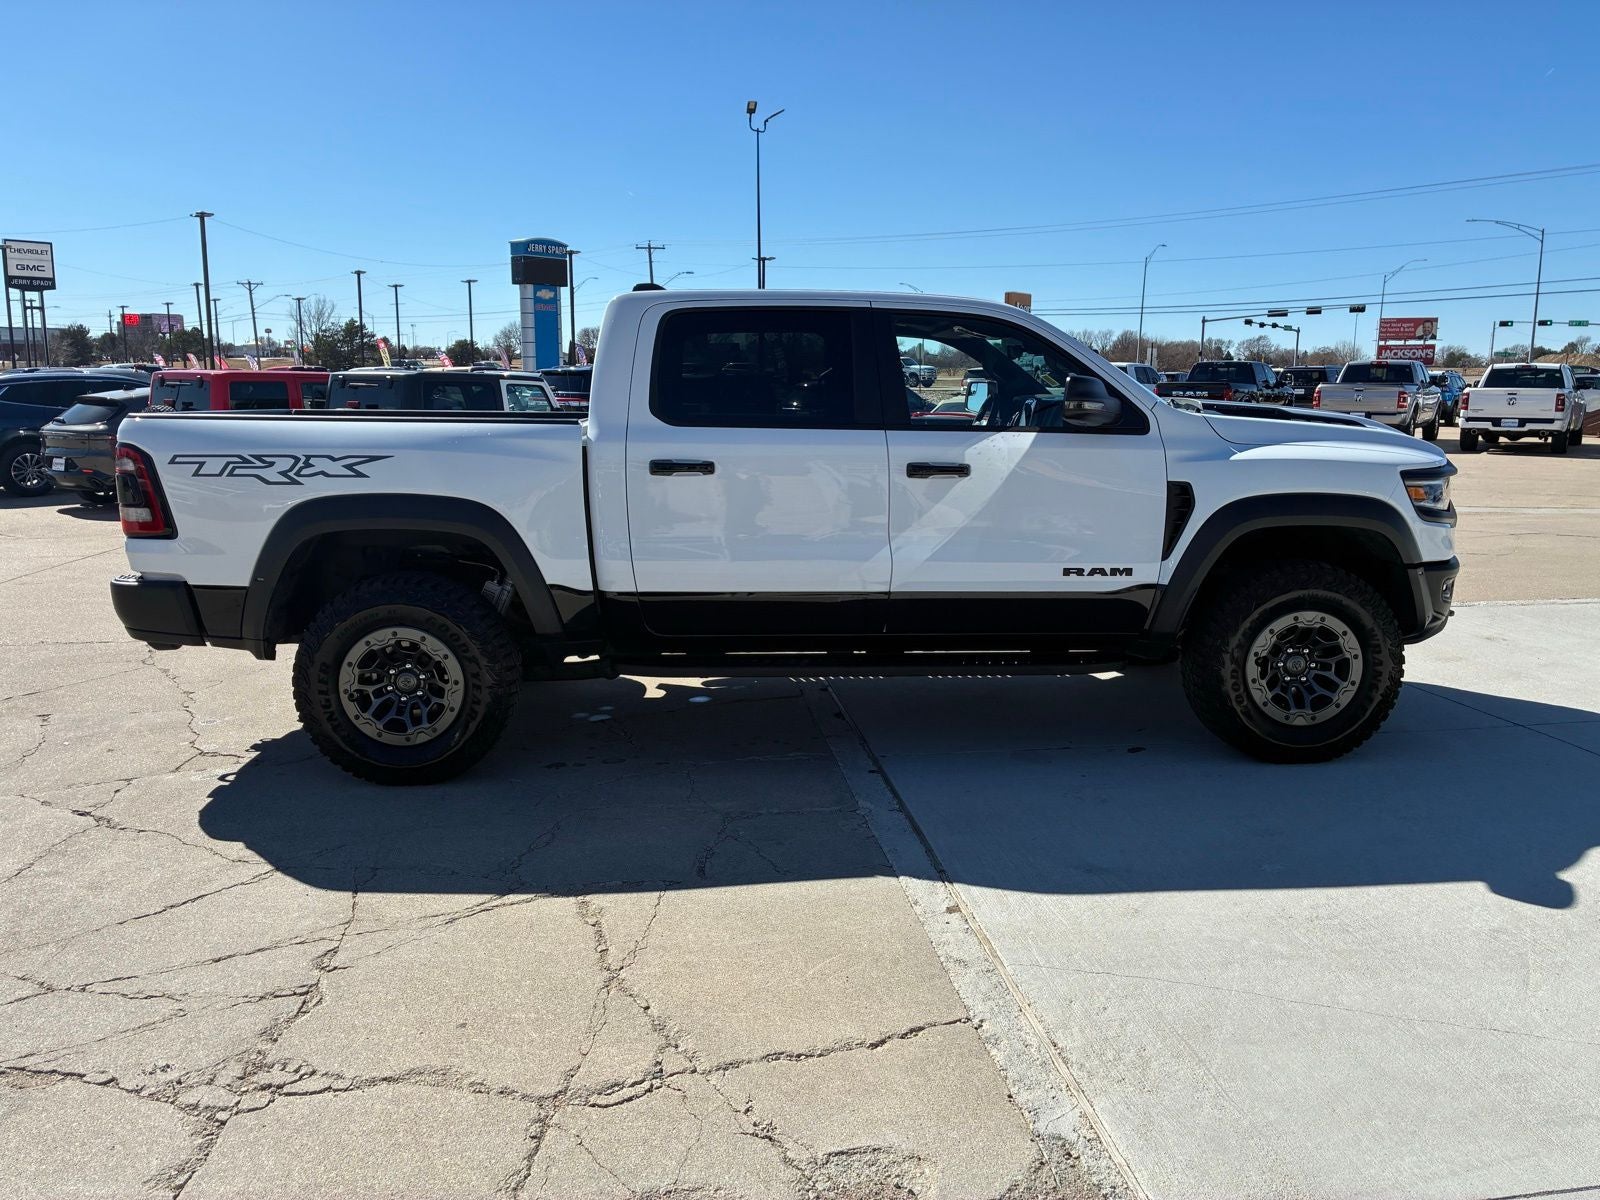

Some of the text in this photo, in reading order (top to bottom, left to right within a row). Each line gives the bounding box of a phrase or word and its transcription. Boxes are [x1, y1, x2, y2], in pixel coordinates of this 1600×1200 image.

[10, 247, 48, 255] CHEVROLET
[528, 243, 547, 253] JERRY
[16, 264, 46, 272] GMC
[1379, 349, 1434, 359] JACKSON'S
[168, 454, 395, 485] TRX
[1062, 567, 1133, 577] RAM
